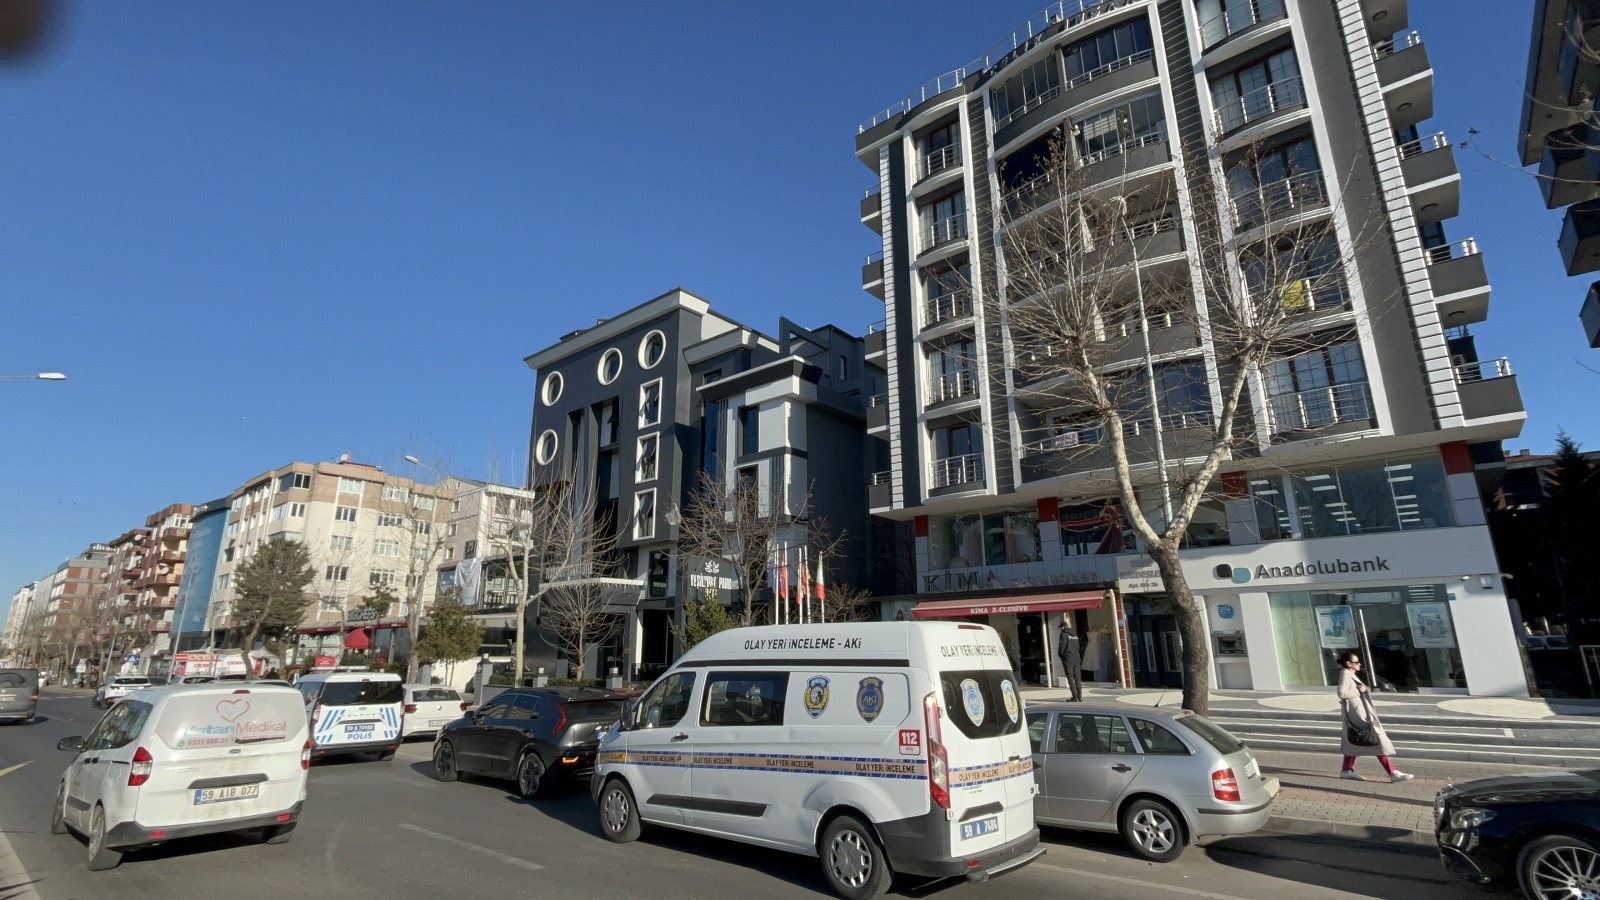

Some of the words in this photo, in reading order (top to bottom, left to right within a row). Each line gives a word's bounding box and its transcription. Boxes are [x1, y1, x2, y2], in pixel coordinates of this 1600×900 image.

[1256, 556, 1391, 579] Anadolubank
[744, 639, 766, 650] OLAY
[767, 639, 787, 650] YERİ
[788, 638, 836, 649] İNCELEME
[843, 637, 862, 649] AKİ
[940, 645, 960, 658] OLAY
[347, 732, 372, 740] POLİS
[901, 731, 918, 745] 112
[766, 758, 778, 766] OLAY
[855, 763, 870, 771] OLAY
[958, 773, 971, 782] OLAY
[202, 790, 214, 800] 59
[219, 787, 237, 799] AIB
[240, 785, 258, 796] 077
[964, 824, 973, 838] 59
[976, 822, 980, 835] A
